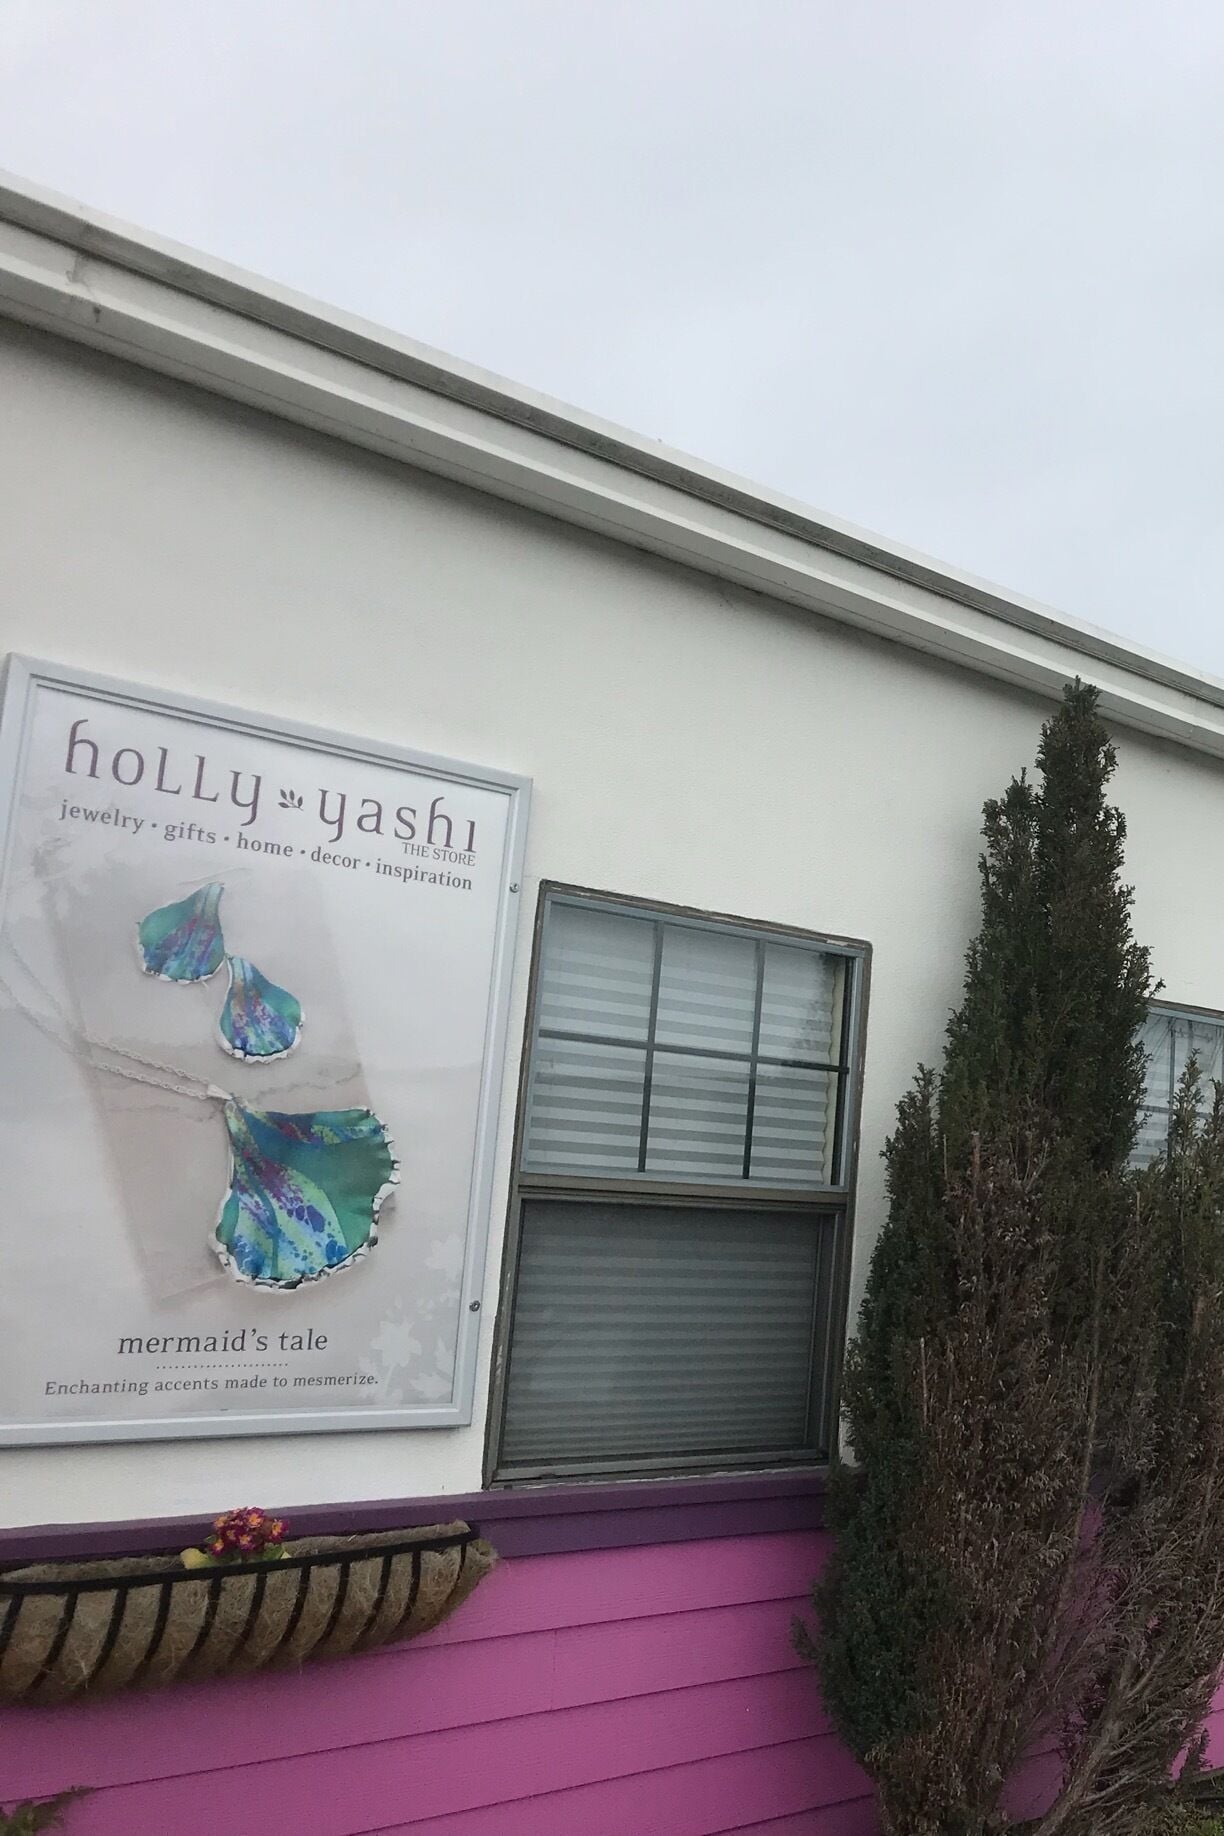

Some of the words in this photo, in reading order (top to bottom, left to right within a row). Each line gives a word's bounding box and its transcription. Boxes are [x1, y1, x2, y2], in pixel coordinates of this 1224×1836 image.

[318, 788, 477, 853] yashi
[59, 799, 144, 834] jewelry
[164, 821, 217, 841] gifts
[237, 832, 294, 857] home
[311, 846, 361, 869] decor
[375, 858, 472, 890] inspiration
[401, 841, 430, 858] THE
[432, 848, 476, 866] STORE
[278, 1328, 328, 1351] tale
[45, 1379, 149, 1396] Enchanting
[155, 1378, 218, 1391] accents
[225, 1374, 268, 1389] made
[273, 1376, 288, 1388] to
[293, 1372, 379, 1387] mesmerize.
